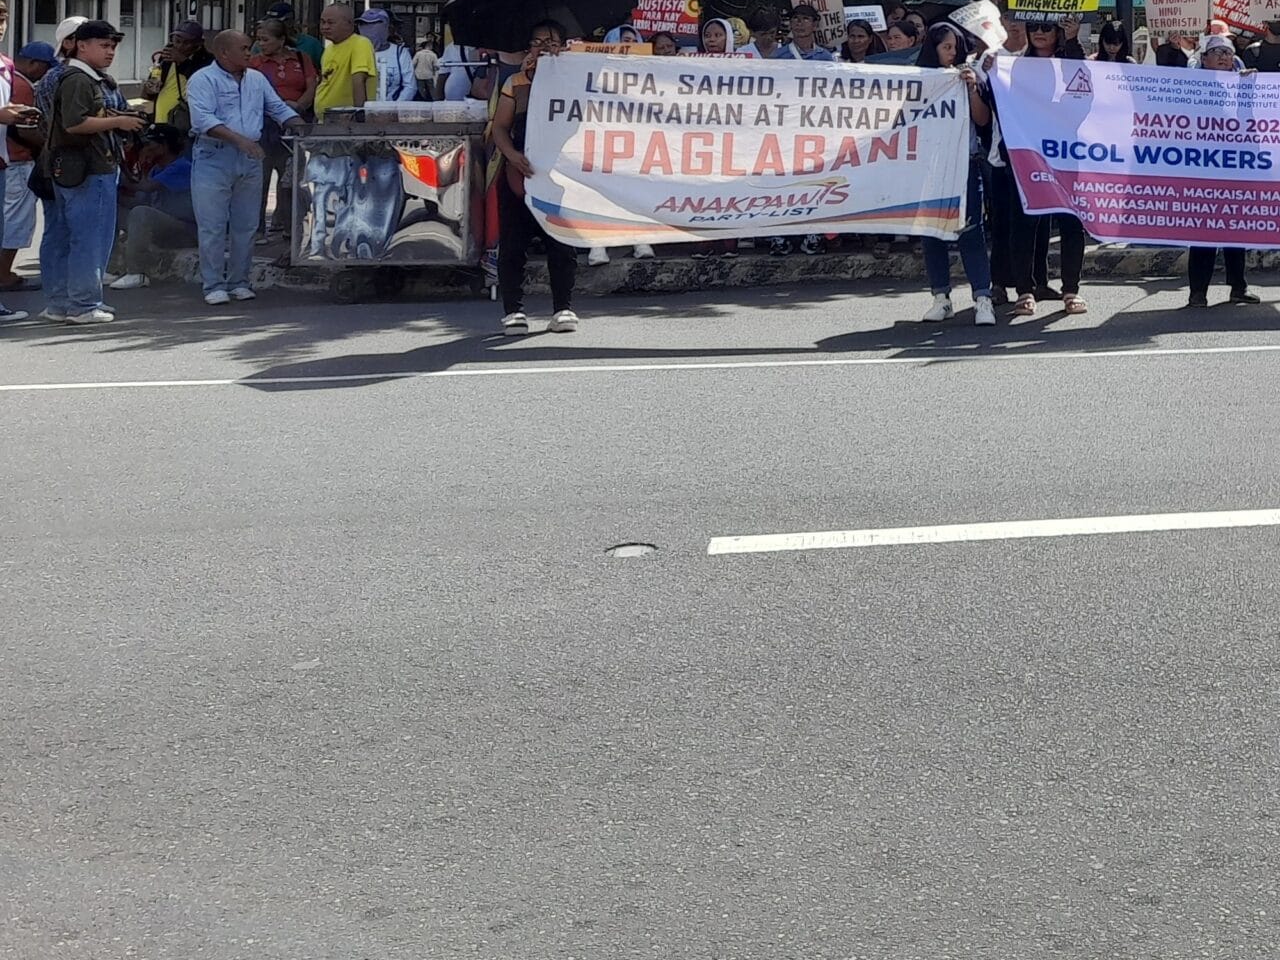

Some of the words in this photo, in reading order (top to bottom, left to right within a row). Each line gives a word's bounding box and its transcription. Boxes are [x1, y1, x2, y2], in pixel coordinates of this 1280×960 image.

[637, 0, 686, 12] HUSTISYA
[1159, 7, 1182, 16] HINDI
[642, 11, 662, 21] PARA
[664, 12, 682, 22] KAY
[824, 11, 842, 24] THE
[585, 71, 666, 97] LUPA,
[677, 74, 782, 99] SAHOD,
[794, 76, 929, 104] TRABAHO,
[1105, 74, 1159, 84] ASSOCIATION
[1160, 77, 1172, 85] OF
[1173, 79, 1225, 89] DEMOCRATIC
[1226, 82, 1253, 90] LABOR
[1117, 84, 1158, 93] KILUSANG
[1159, 87, 1182, 95] MAYO
[1184, 88, 1201, 96] UNO
[1209, 90, 1232, 98] BICOL
[1146, 95, 1164, 103] SAN
[1165, 96, 1192, 105] ISIDRO
[1193, 98, 1237, 107] LABRADOR
[1238, 100, 1278, 108] INSTITUTE
[548, 99, 743, 126] PANINIRAHAN
[754, 103, 790, 127] AT
[800, 99, 956, 130] KARAPATAN
[1133, 112, 1190, 129] MAYO
[1197, 115, 1241, 133] UNO
[1131, 128, 1171, 140] ARAW
[1174, 130, 1193, 141] NG
[581, 125, 919, 177] IPAGLABAN!
[1041, 139, 1125, 163] BICOL
[1133, 144, 1273, 170] WORKERS
[653, 182, 851, 214] ANAKPAWIS
[1073, 181, 1180, 198] MANGGAGAWA,
[1183, 188, 1257, 200] MAGKAISA!
[688, 206, 819, 224] PARTY-LIST
[1094, 197, 1169, 211] WAKASAN!
[1172, 201, 1218, 215] BUHAY
[1221, 204, 1239, 215] AT
[1098, 213, 1203, 228] NAKABUBUHAY
[1206, 217, 1226, 229] NA
[1229, 220, 1280, 233] SAHOD,
